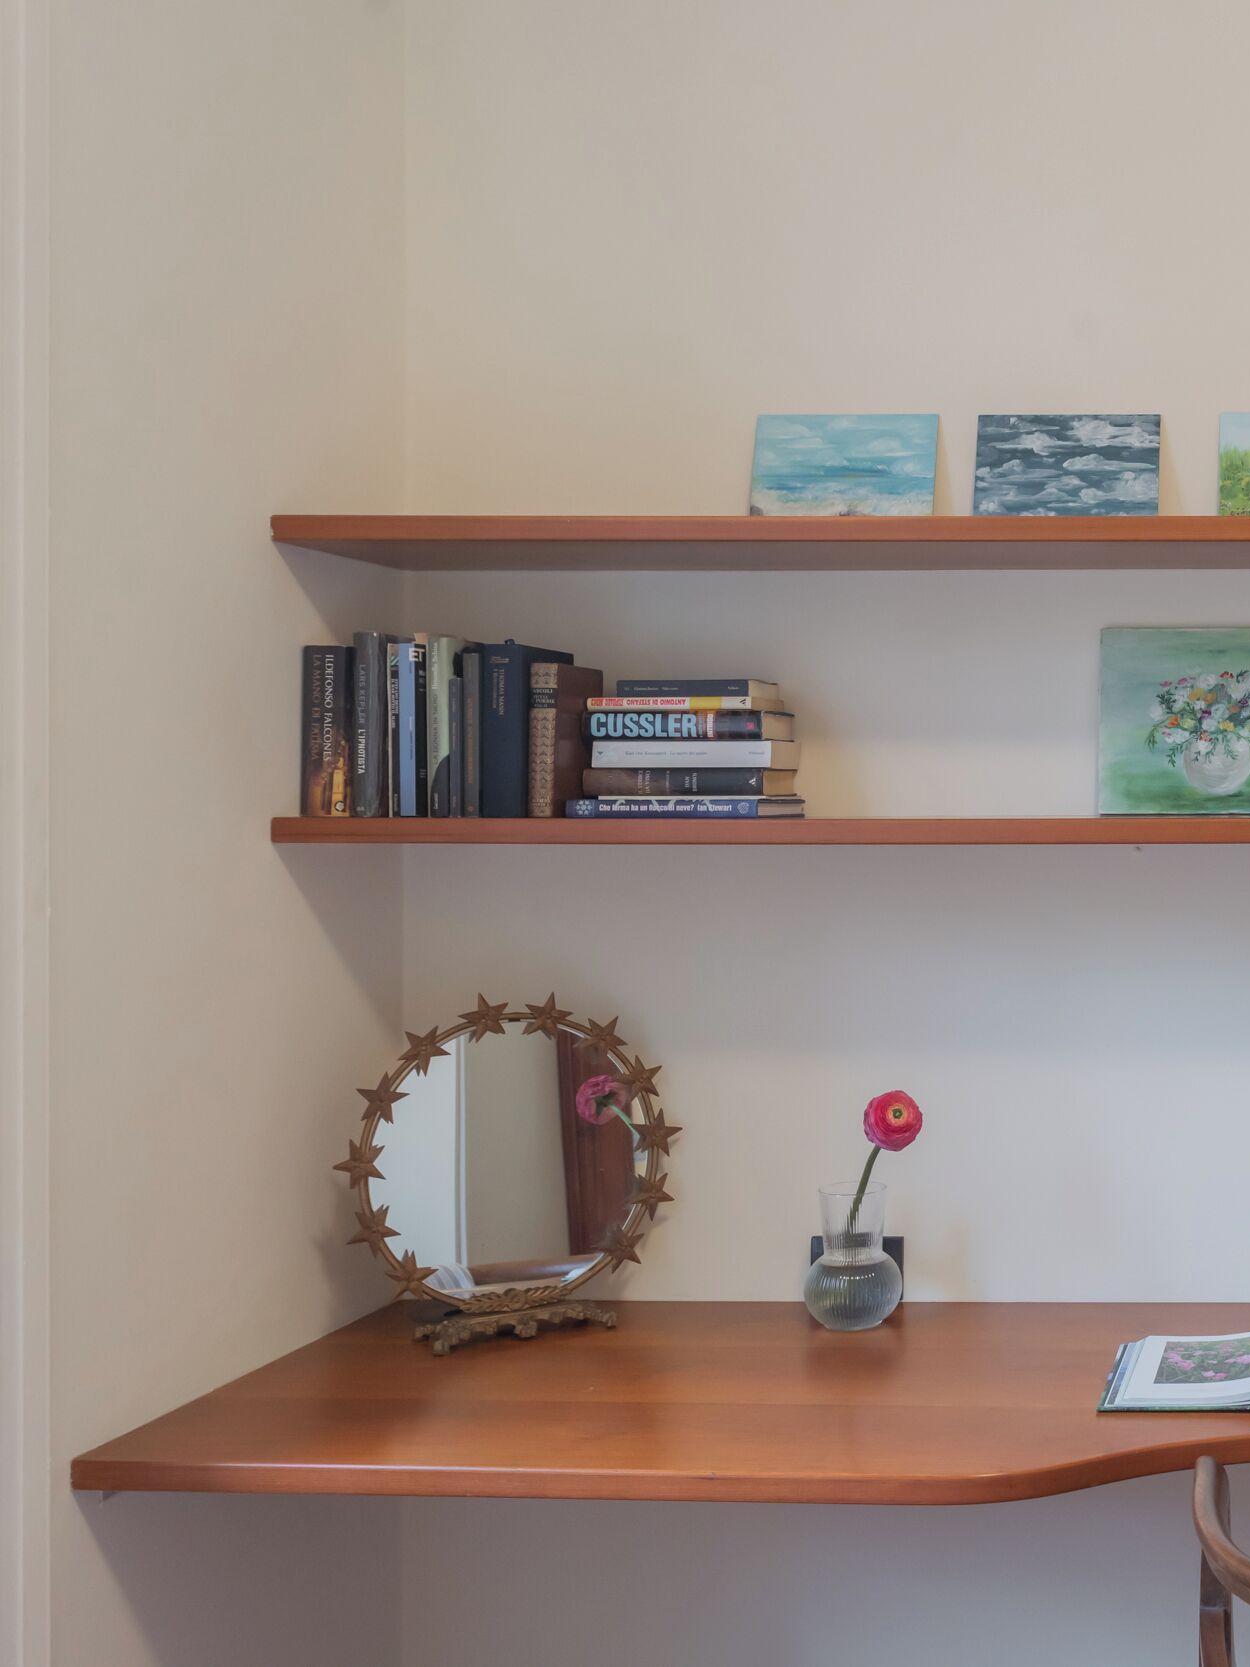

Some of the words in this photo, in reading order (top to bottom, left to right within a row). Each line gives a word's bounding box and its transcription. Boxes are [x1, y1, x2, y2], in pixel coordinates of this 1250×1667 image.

[408, 647, 425, 662] ET
[311, 670, 321, 703] MANO
[323, 654, 335, 708] ILDEFONSO
[359, 664, 367, 687] LARS
[358, 689, 367, 724] KEPLER
[626, 698, 651, 706] STEFANO
[651, 698, 659, 706] DI
[660, 698, 686, 706] ANTONIO
[590, 712, 698, 738] CUSSLER
[322, 713, 333, 761] FALCONES
[357, 729, 366, 774] L'IPNOTISTA
[599, 804, 611, 812] Che
[612, 804, 630, 812] forma
[631, 804, 639, 812] ha
[640, 804, 648, 812] un
[676, 804, 695, 812] neve?
[697, 804, 708, 812] Ian
[708, 804, 732, 812] Stewart
